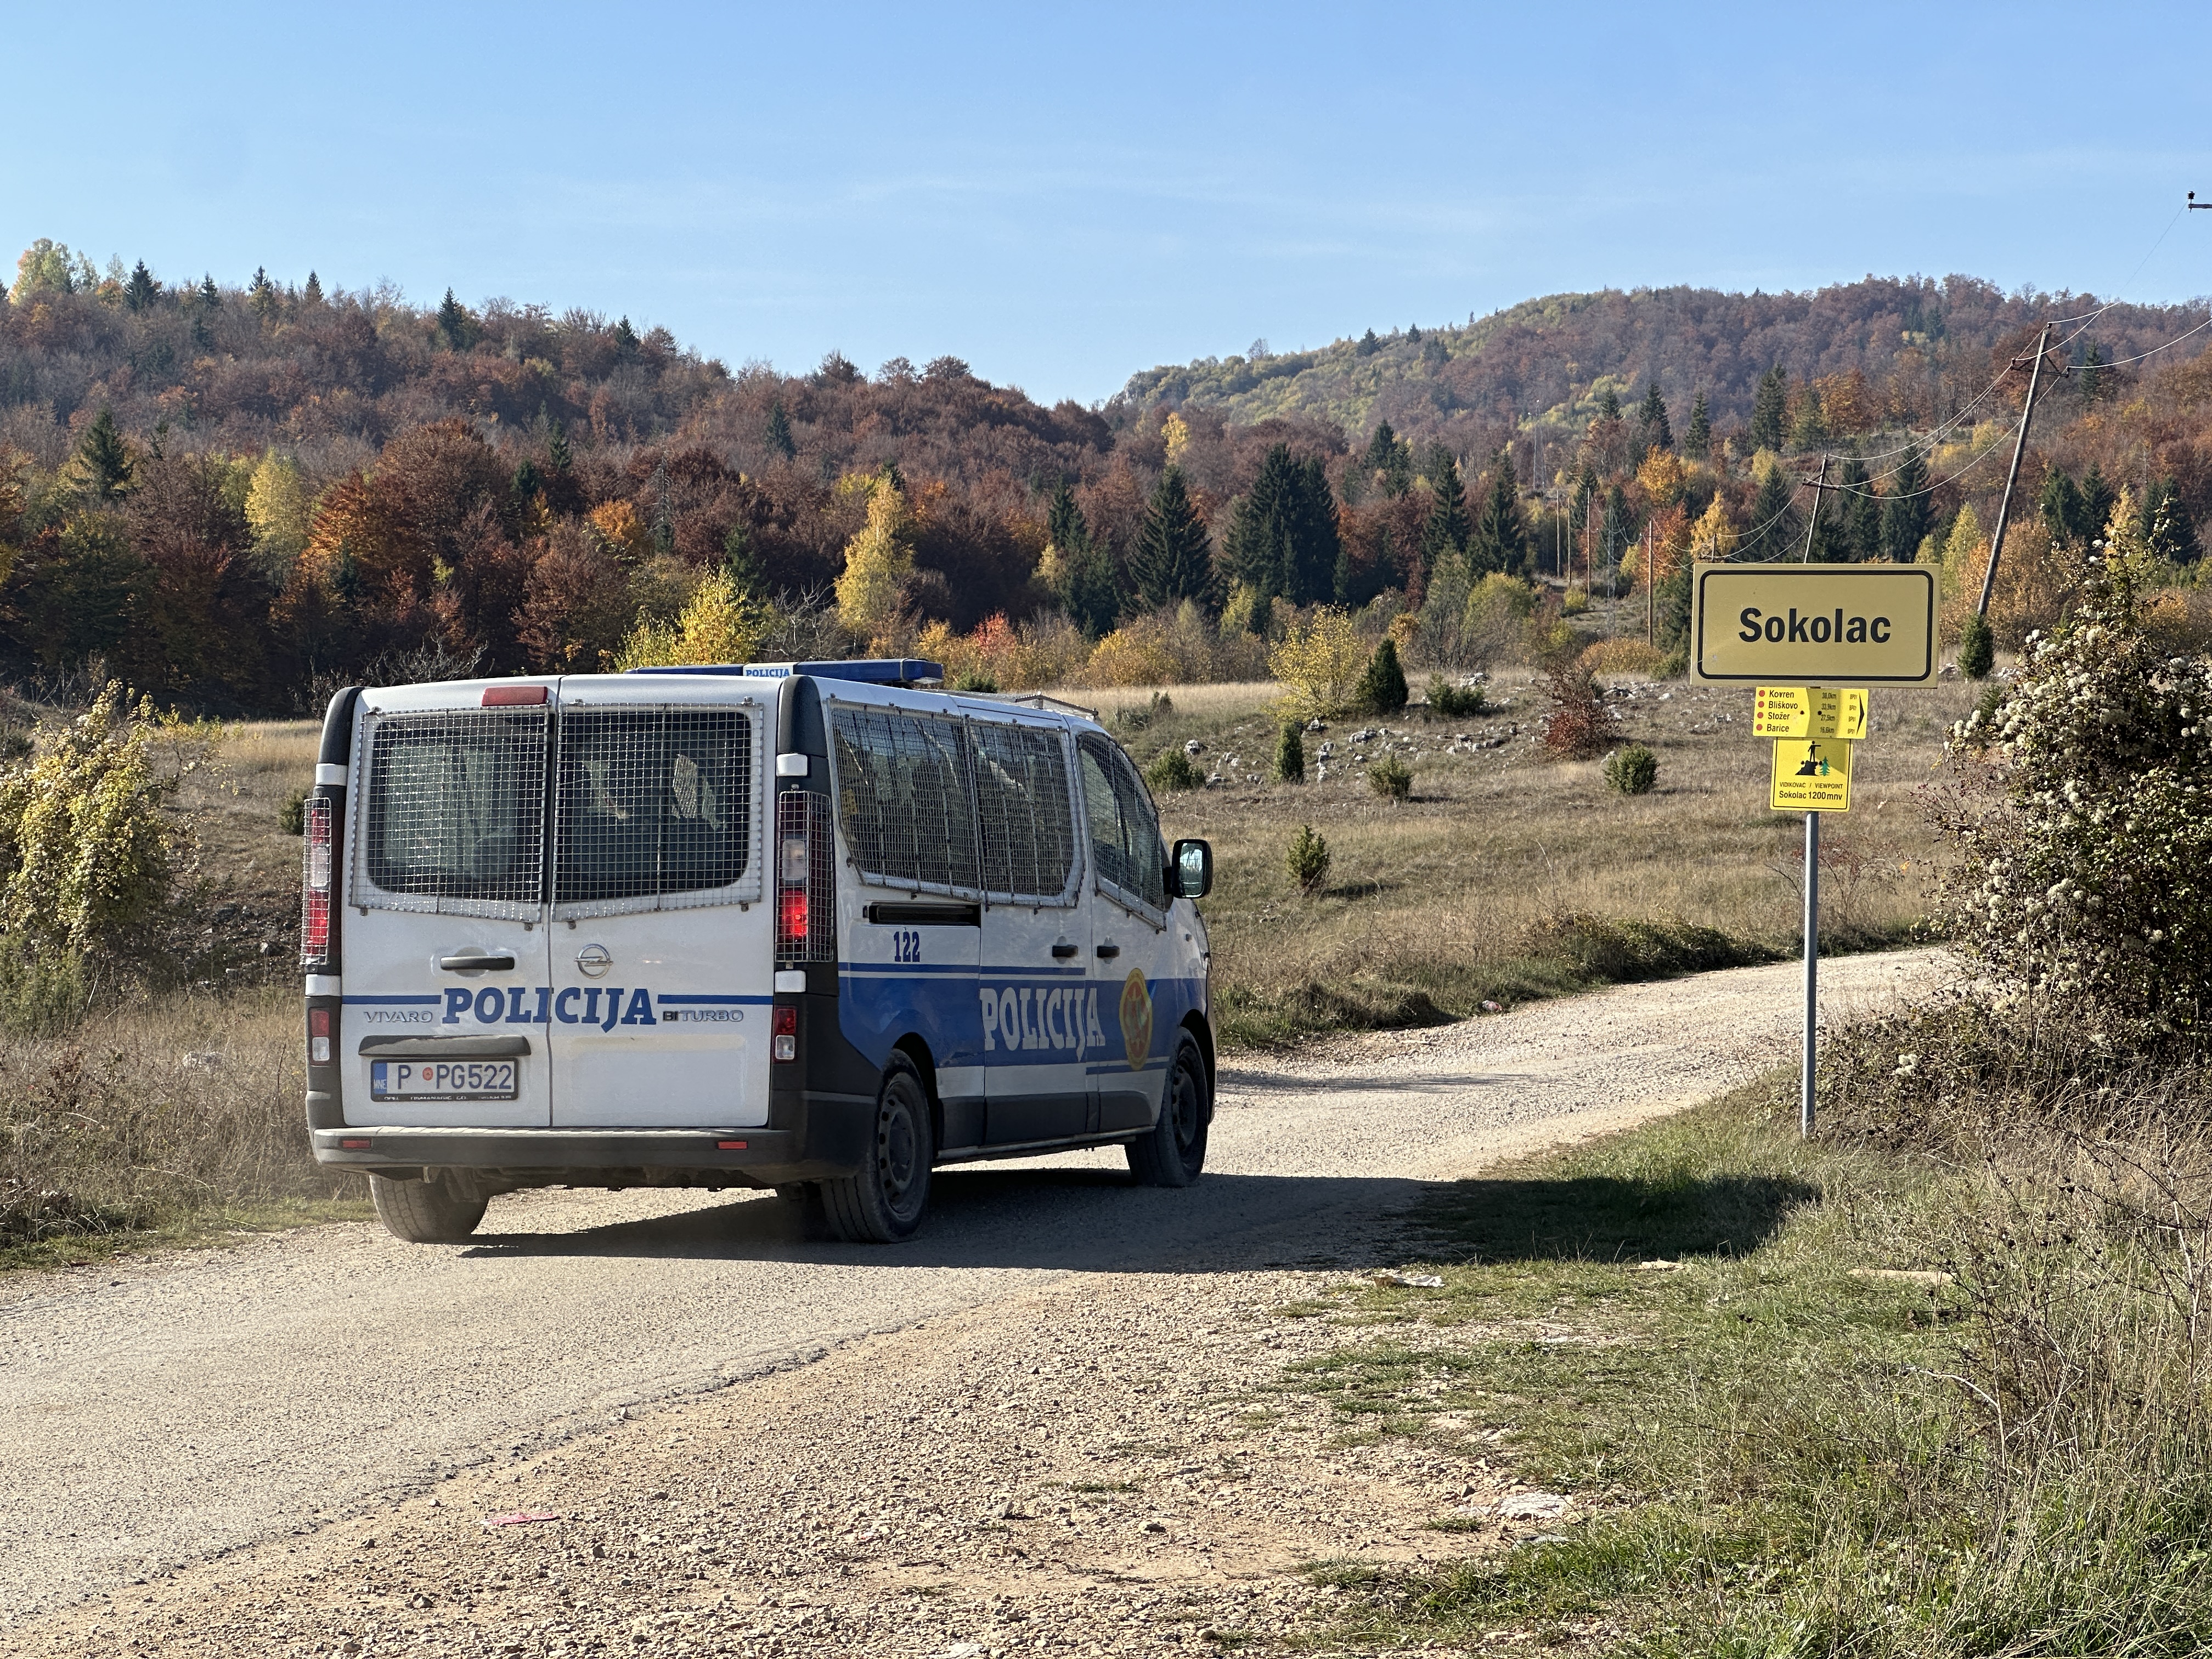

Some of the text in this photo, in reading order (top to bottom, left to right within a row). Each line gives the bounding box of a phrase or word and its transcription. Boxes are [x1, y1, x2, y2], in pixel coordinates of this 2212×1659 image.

[1739, 607, 1891, 643] Sokolac
[746, 669, 790, 678] POLICIJA
[1769, 690, 1795, 698] Kovren
[1768, 701, 1798, 709] Bliškovo
[1768, 712, 1790, 720] Stožer
[1767, 724, 1790, 732] Barice
[1779, 791, 1807, 799] Sokolac
[893, 931, 920, 962] 122
[442, 987, 657, 1032] POLICIJA
[364, 1011, 433, 1023] VIVARO
[979, 987, 1105, 1063] POLICIJA
[398, 1064, 512, 1090] P PG522
[374, 1079, 387, 1090] MNE
